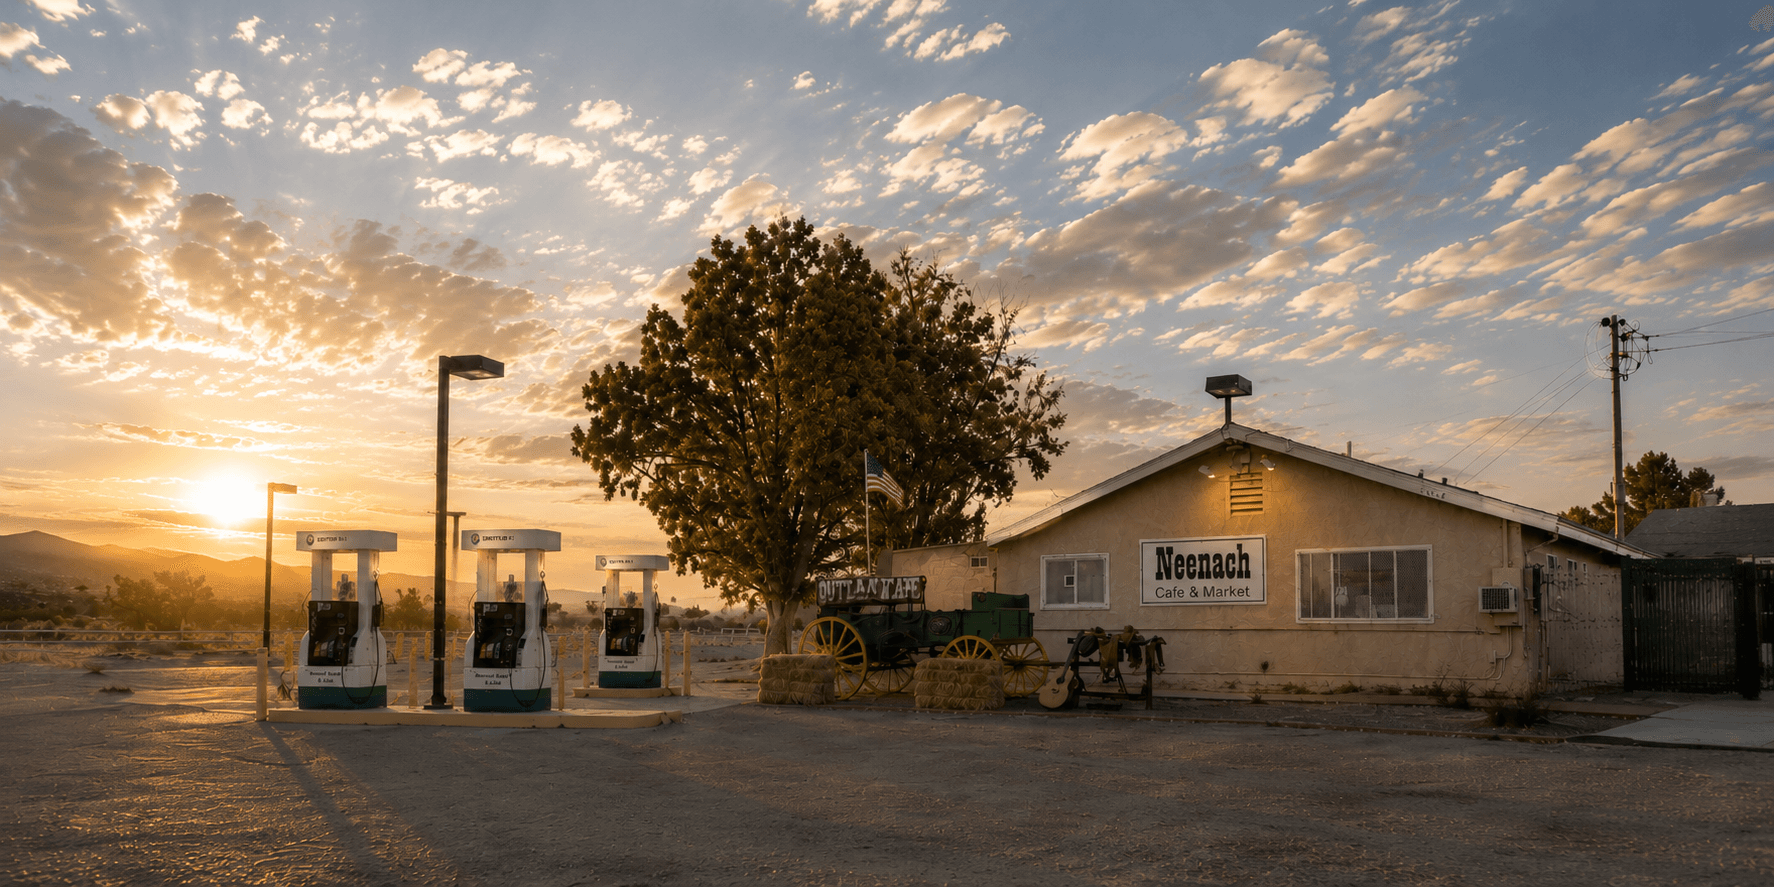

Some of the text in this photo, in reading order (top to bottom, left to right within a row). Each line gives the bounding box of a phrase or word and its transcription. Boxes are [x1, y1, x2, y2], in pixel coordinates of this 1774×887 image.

[1155, 543, 1251, 580] Neenach
[1155, 585, 1251, 598] Cafe & Market
